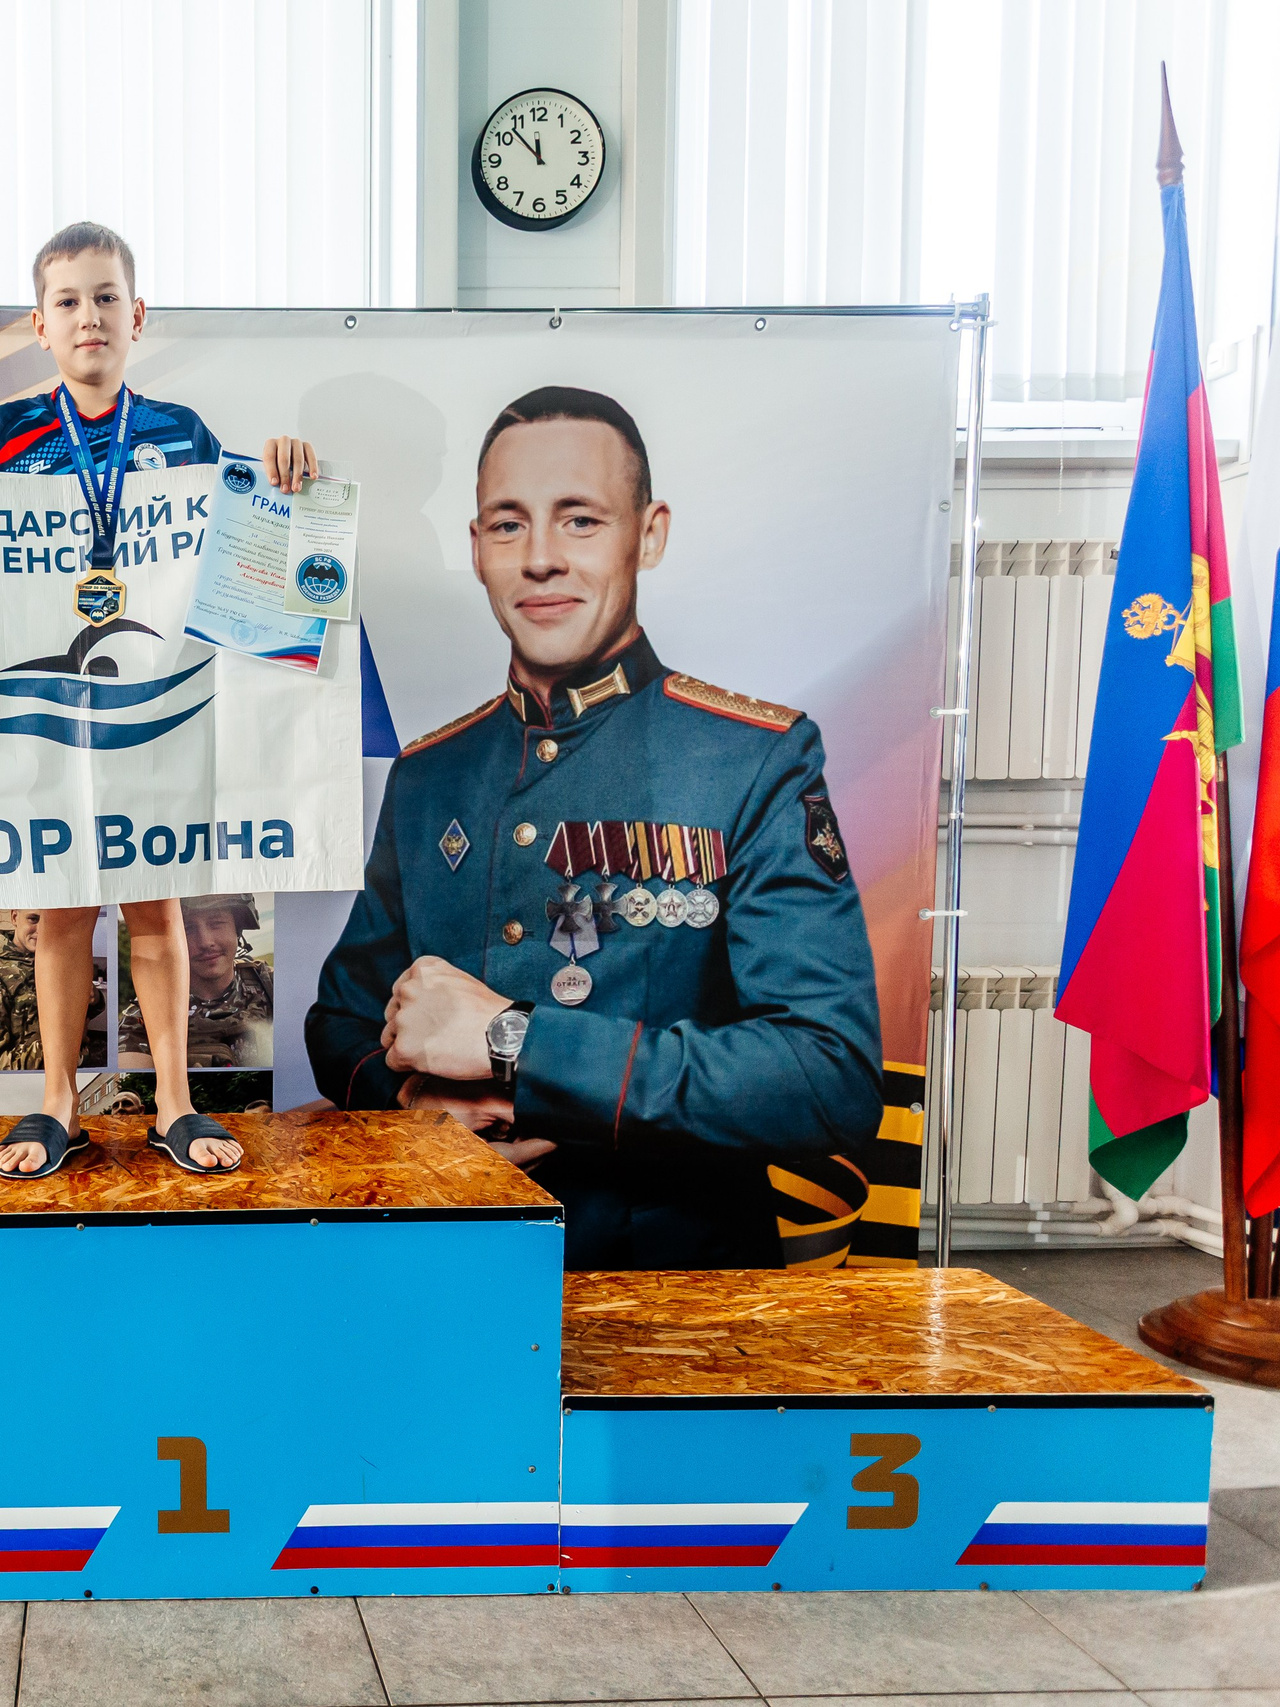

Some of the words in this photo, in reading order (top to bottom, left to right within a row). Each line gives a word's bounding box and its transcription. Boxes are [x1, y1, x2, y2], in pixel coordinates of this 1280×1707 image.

[511, 114, 524, 129] 11
[529, 107, 548, 122] 12
[557, 113, 564, 128] 1
[495, 131, 513, 146] 10
[570, 130, 582, 145] 2
[488, 153, 502, 168] 9
[577, 151, 590, 166] 3
[496, 176, 509, 191] 8
[570, 174, 583, 188] 4
[513, 191, 524, 207] 7
[555, 190, 568, 205] 5
[532, 198, 546, 213] 6
[252, 494, 290, 518] ГРАМ
[94, 814, 295, 871] Волна
[157, 1437, 230, 1533] 1
[846, 1433, 922, 1530] 3
